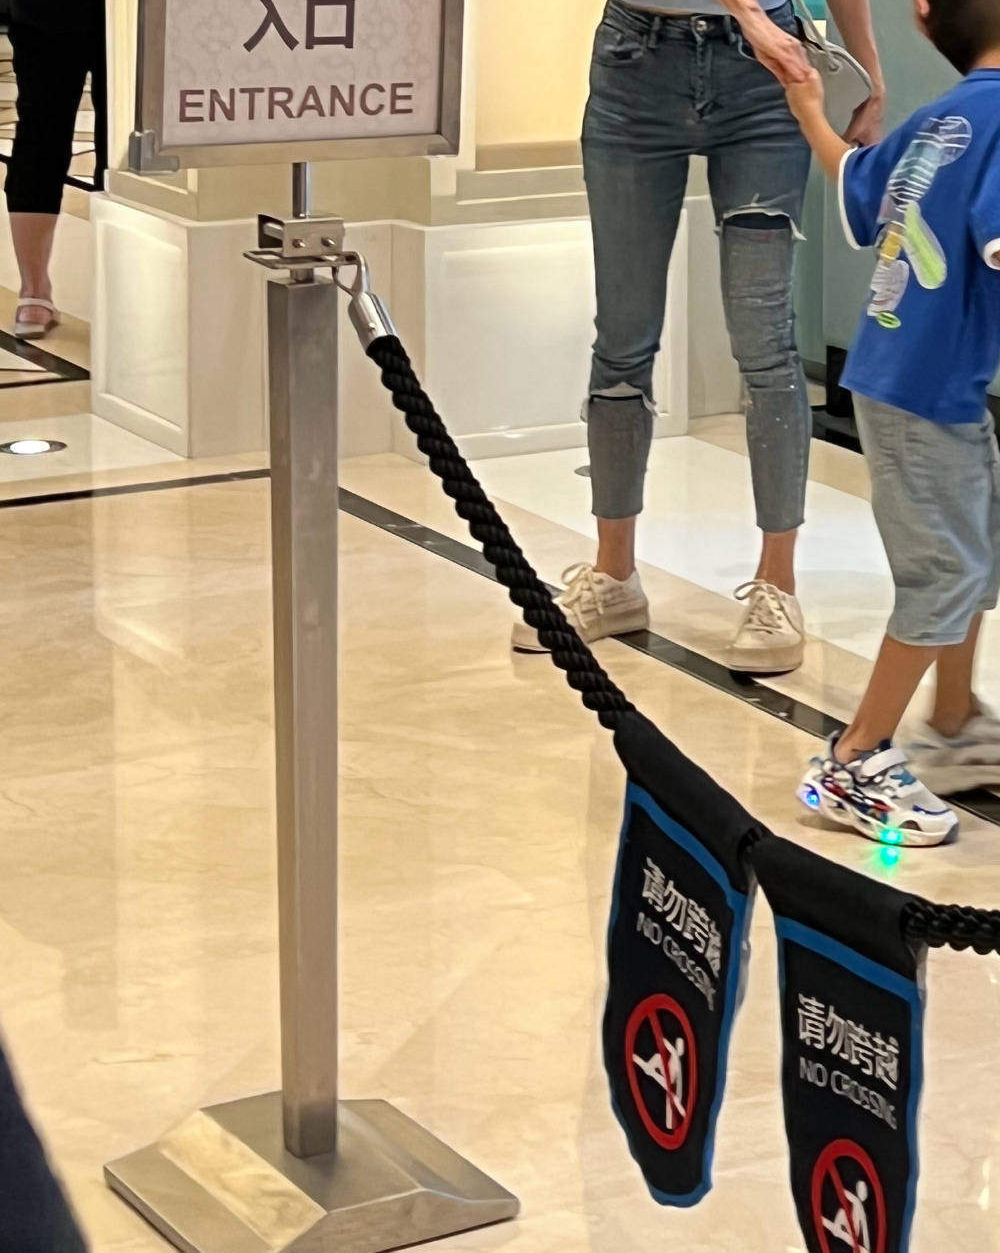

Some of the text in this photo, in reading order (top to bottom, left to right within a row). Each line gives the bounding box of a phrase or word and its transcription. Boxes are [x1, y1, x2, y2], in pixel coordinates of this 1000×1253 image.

[179, 82, 414, 123] ENTRANCE
[636, 911, 662, 947] NO
[799, 1056, 828, 1089] NO
